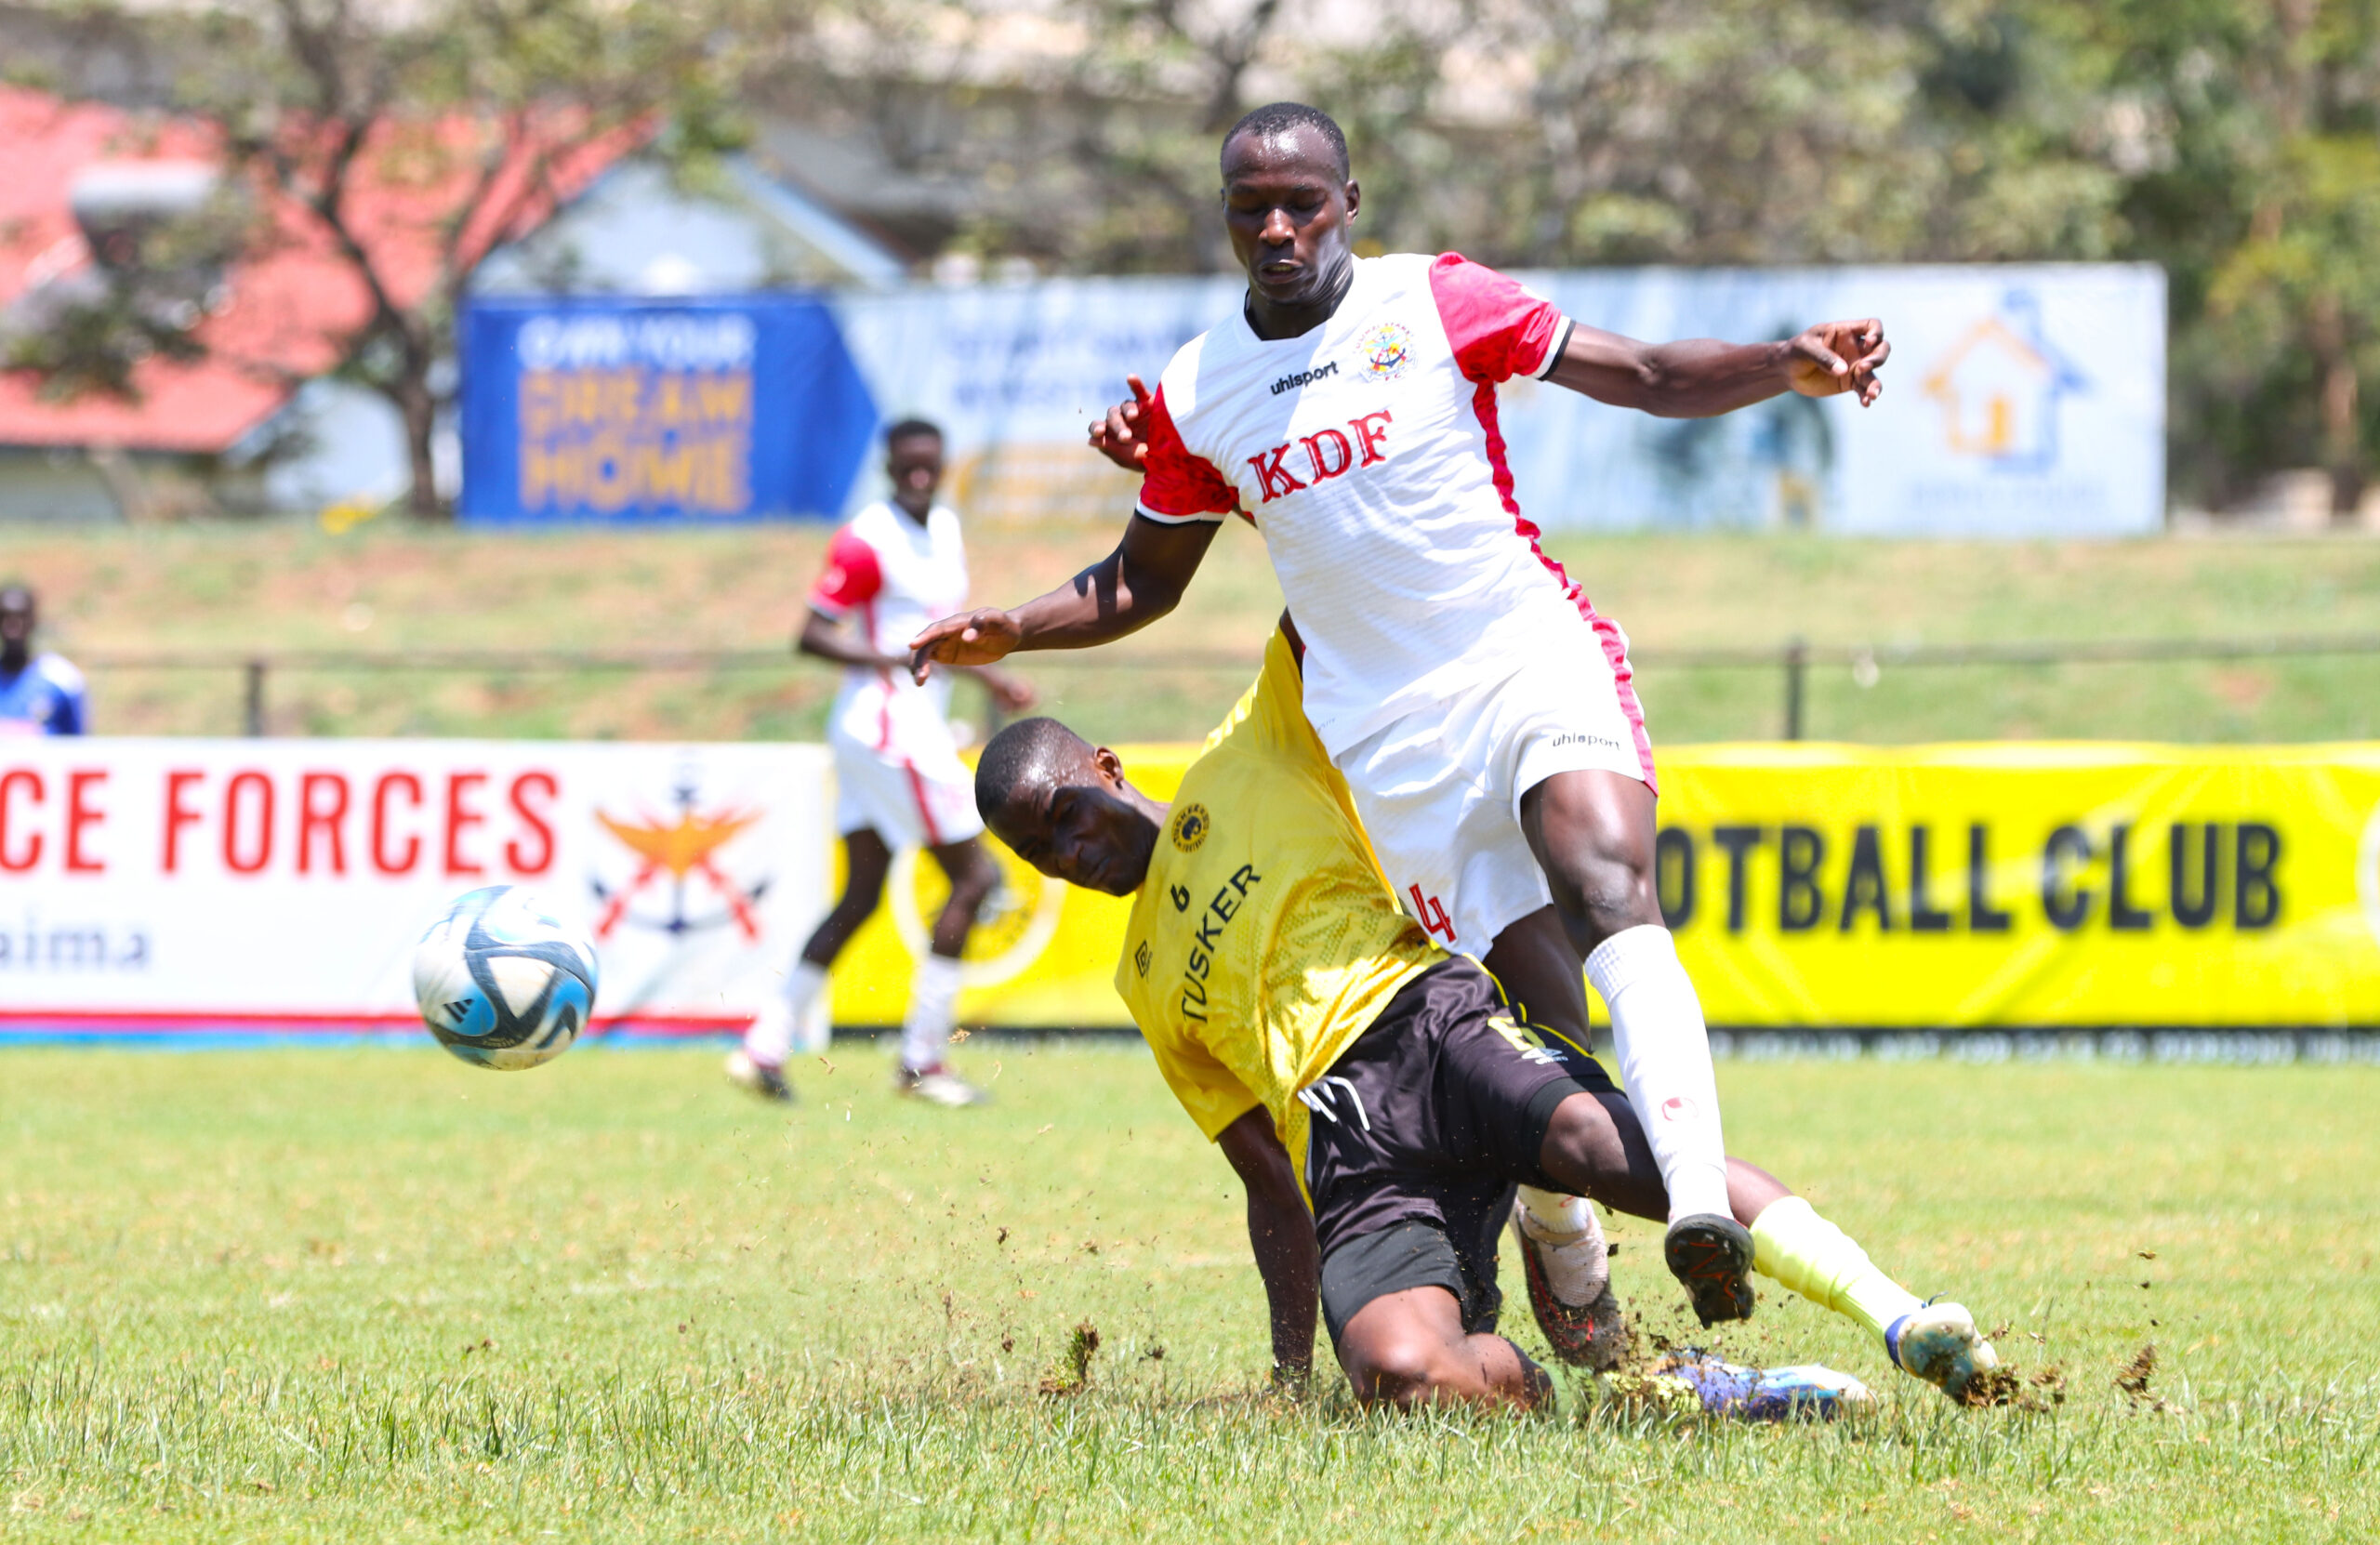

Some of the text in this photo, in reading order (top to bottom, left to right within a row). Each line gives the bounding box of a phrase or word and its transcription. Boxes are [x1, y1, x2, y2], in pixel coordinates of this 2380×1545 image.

[640, 317, 755, 367] YOUR
[519, 368, 751, 437] DREAM
[1271, 361, 1339, 395] uhlsport
[519, 439, 751, 511] HOME
[1247, 410, 1393, 504] KDF
[1553, 732, 1620, 751] uhlsport
[0, 770, 560, 877] CE FORCES
[1170, 883, 1190, 913] 6
[1656, 821, 2283, 932] OTBALL CLUB
[1181, 864, 1262, 1023] TUSKER
[1408, 883, 1457, 943] 4
